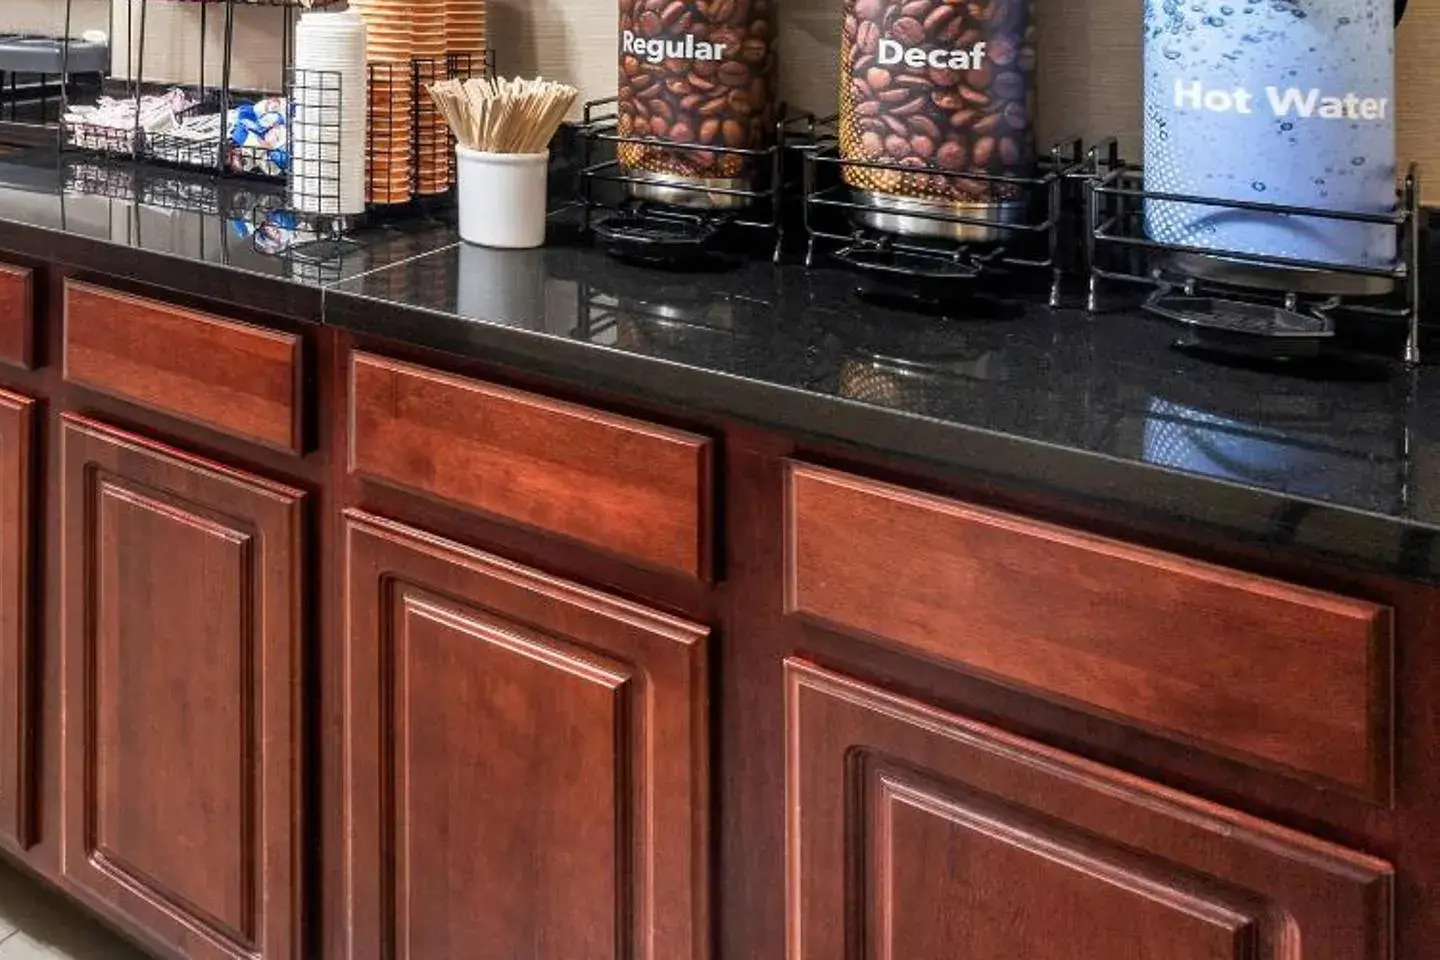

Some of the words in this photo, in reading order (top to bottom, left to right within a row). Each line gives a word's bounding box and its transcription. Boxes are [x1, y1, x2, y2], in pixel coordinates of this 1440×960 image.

[623, 30, 727, 63] Regular
[878, 39, 987, 70] Decaf
[1173, 77, 1253, 114] Hot
[1265, 86, 1389, 120] Water
